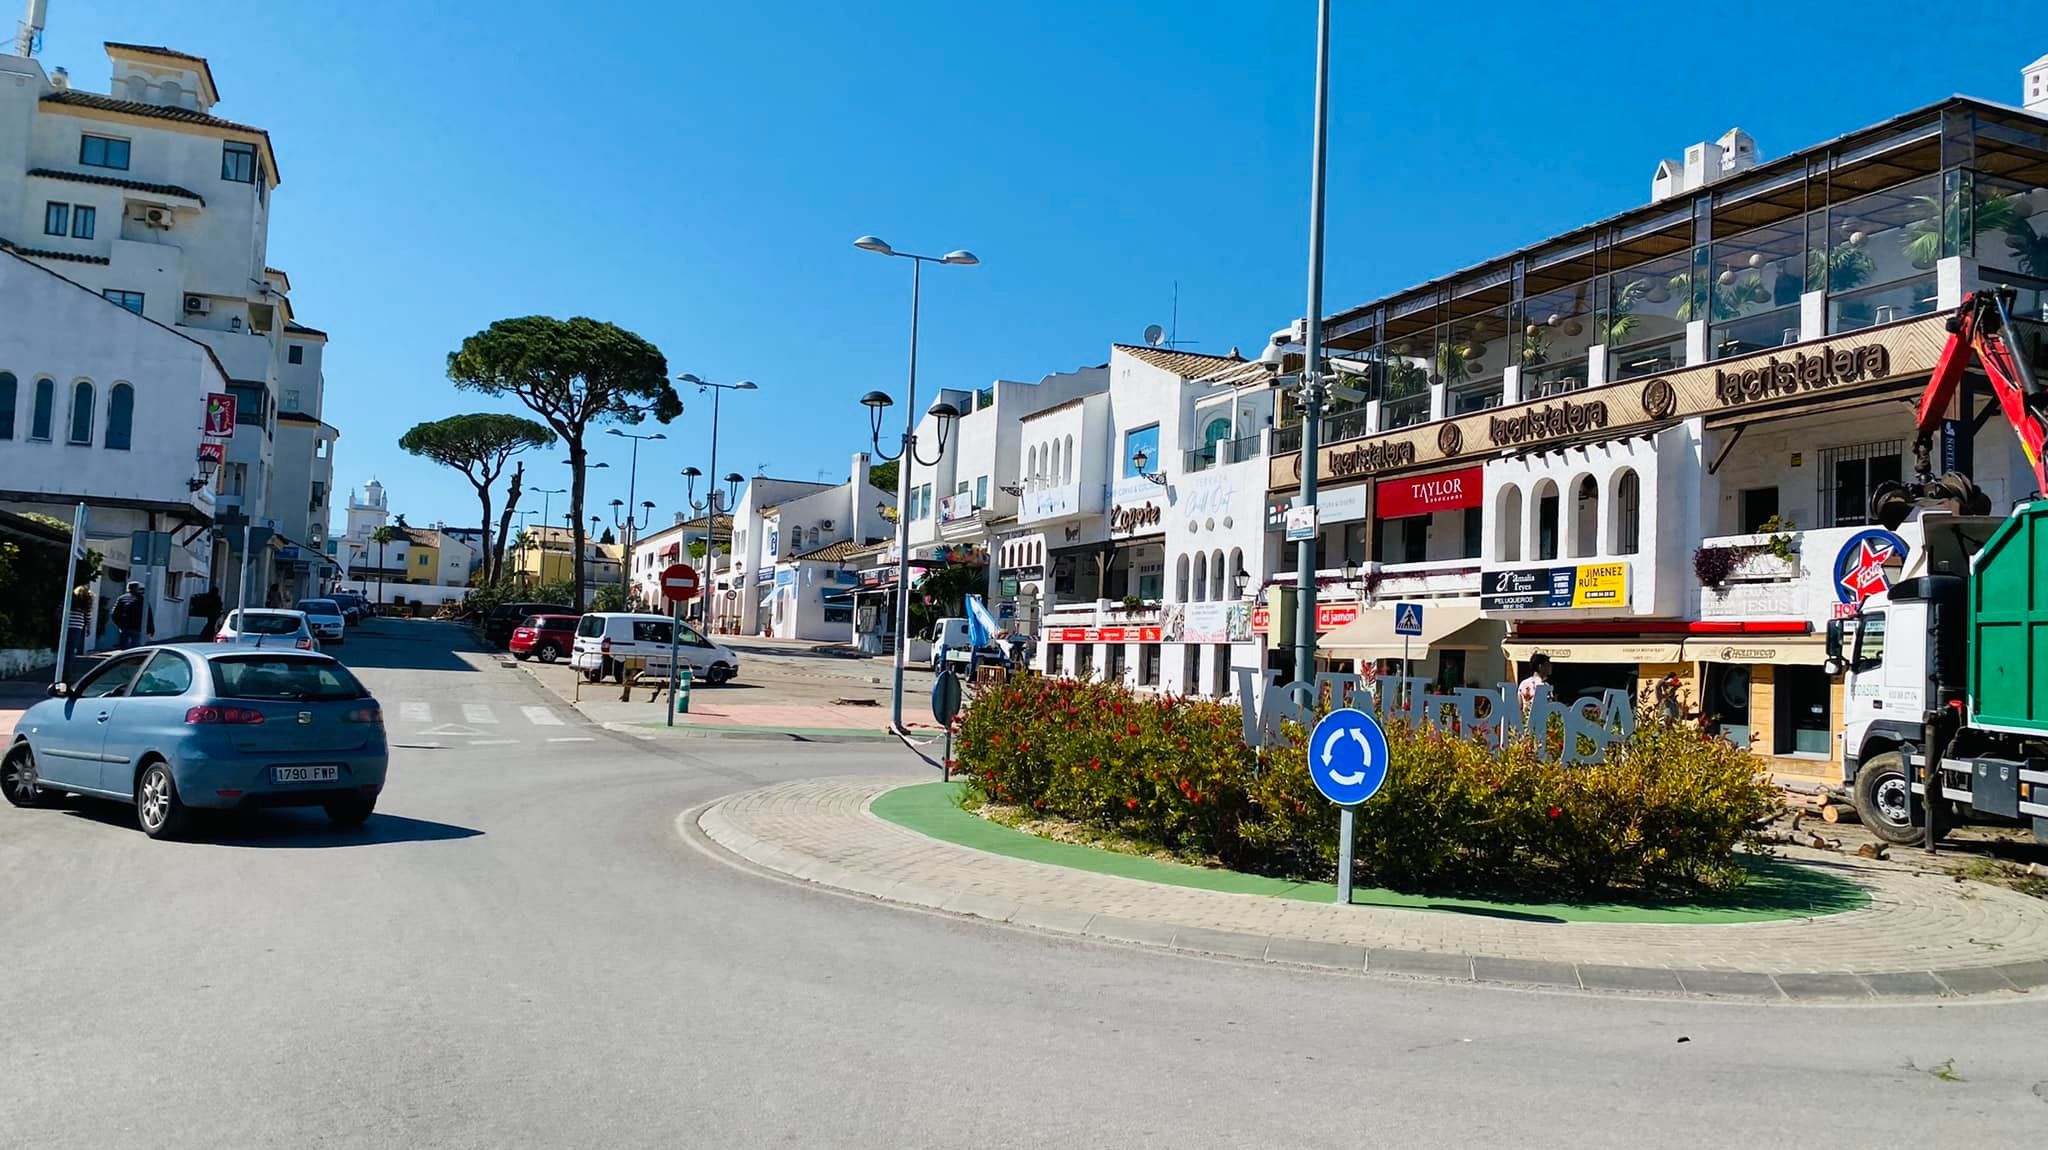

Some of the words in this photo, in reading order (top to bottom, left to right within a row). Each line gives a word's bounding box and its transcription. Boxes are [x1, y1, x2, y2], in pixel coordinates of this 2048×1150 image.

[1715, 343, 1890, 405] lacristalera
[1411, 478, 1463, 504] TAYLOR
[1586, 567, 1623, 578] JIMENEZ
[1579, 578, 1599, 588] RUIZ
[1494, 596, 1534, 605] PELUQUEROS
[279, 768, 307, 780] 1790
[314, 768, 336, 779] FWP
